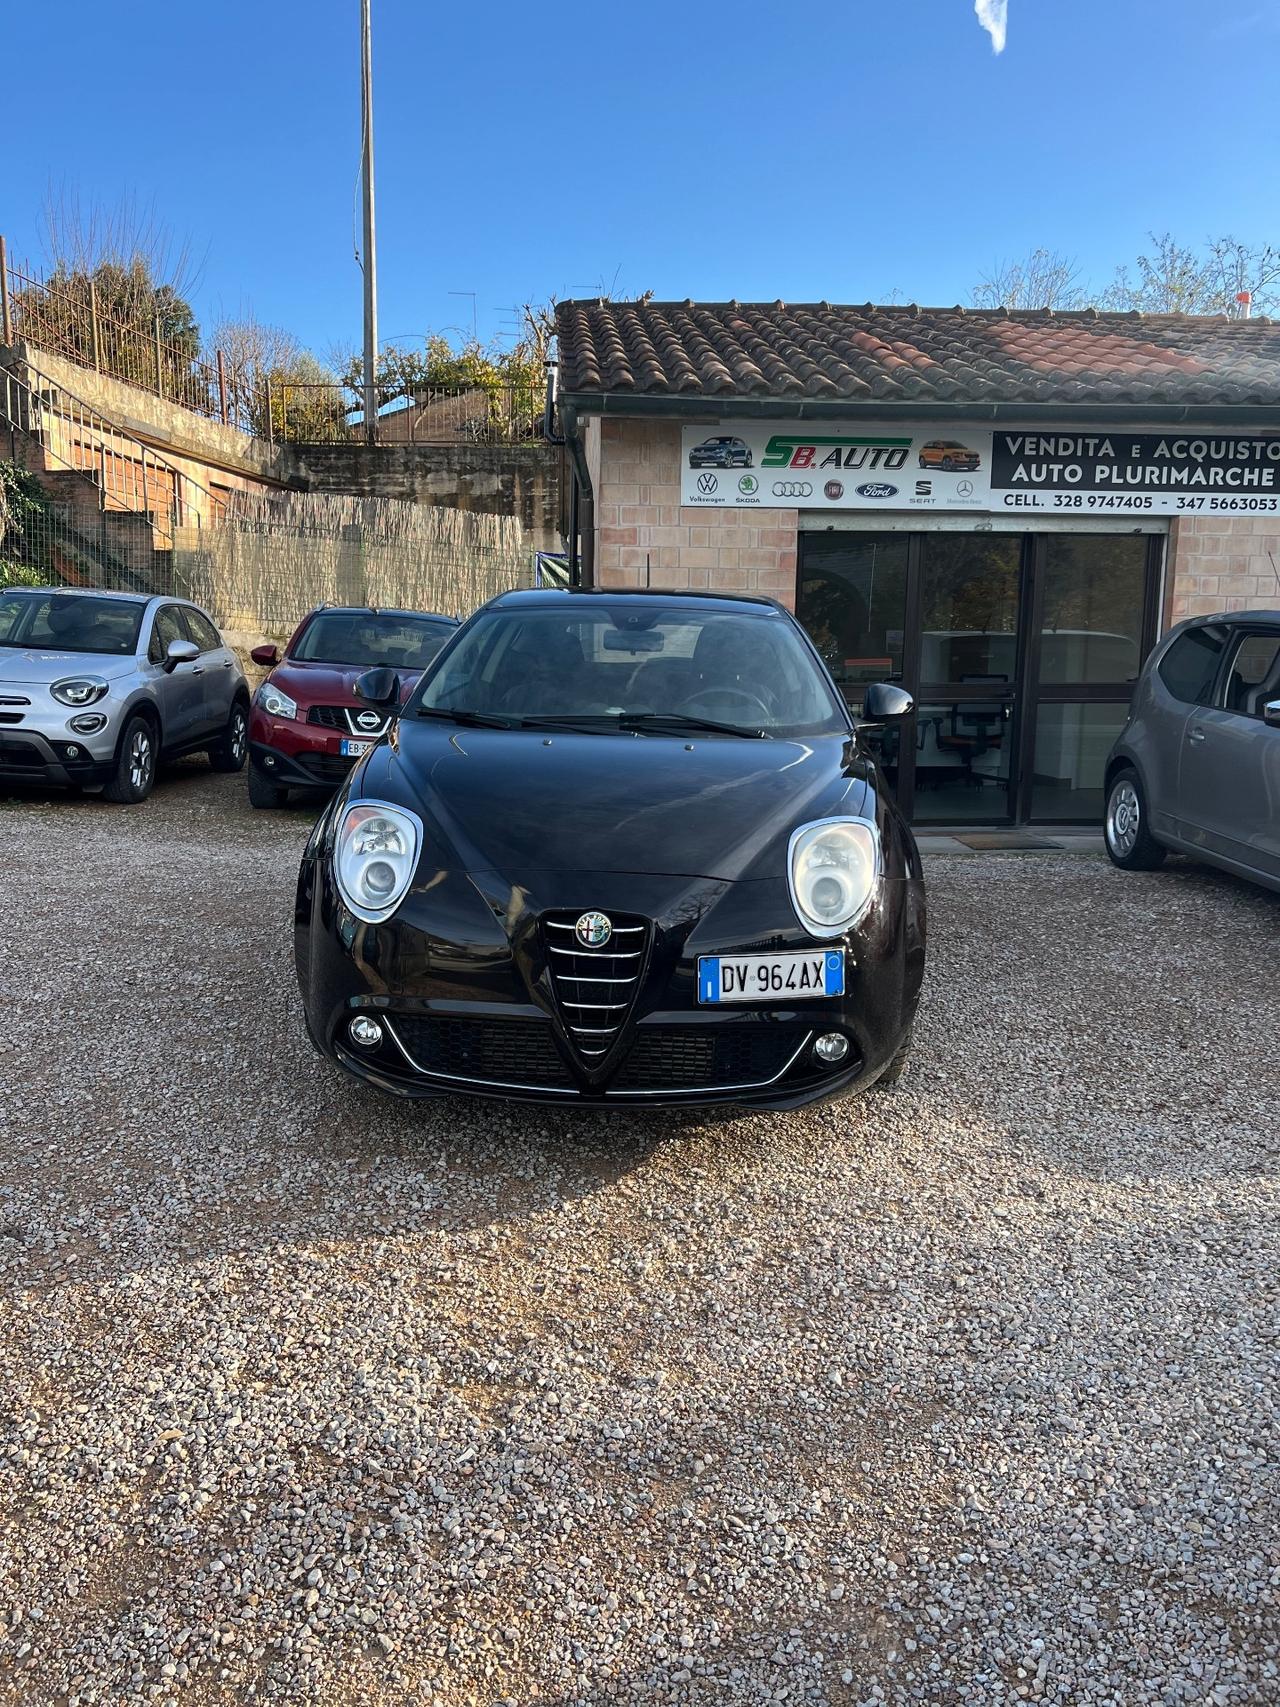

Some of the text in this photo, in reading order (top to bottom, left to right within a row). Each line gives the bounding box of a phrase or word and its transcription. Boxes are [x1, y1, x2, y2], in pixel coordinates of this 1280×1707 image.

[1005, 436, 1115, 457] VENDITA
[1153, 439, 1280, 463] ACQUISTO
[1011, 463, 1275, 486] AUTO PLURIMARCHE
[863, 484, 892, 497] Ford
[1003, 494, 1045, 507] CELL.
[1053, 494, 1083, 507] 328
[1087, 495, 1153, 508] 9747405
[1176, 497, 1206, 509] 347
[1209, 498, 1277, 511] 5663053
[721, 964, 749, 993] DV
[757, 960, 824, 992] 964AX
